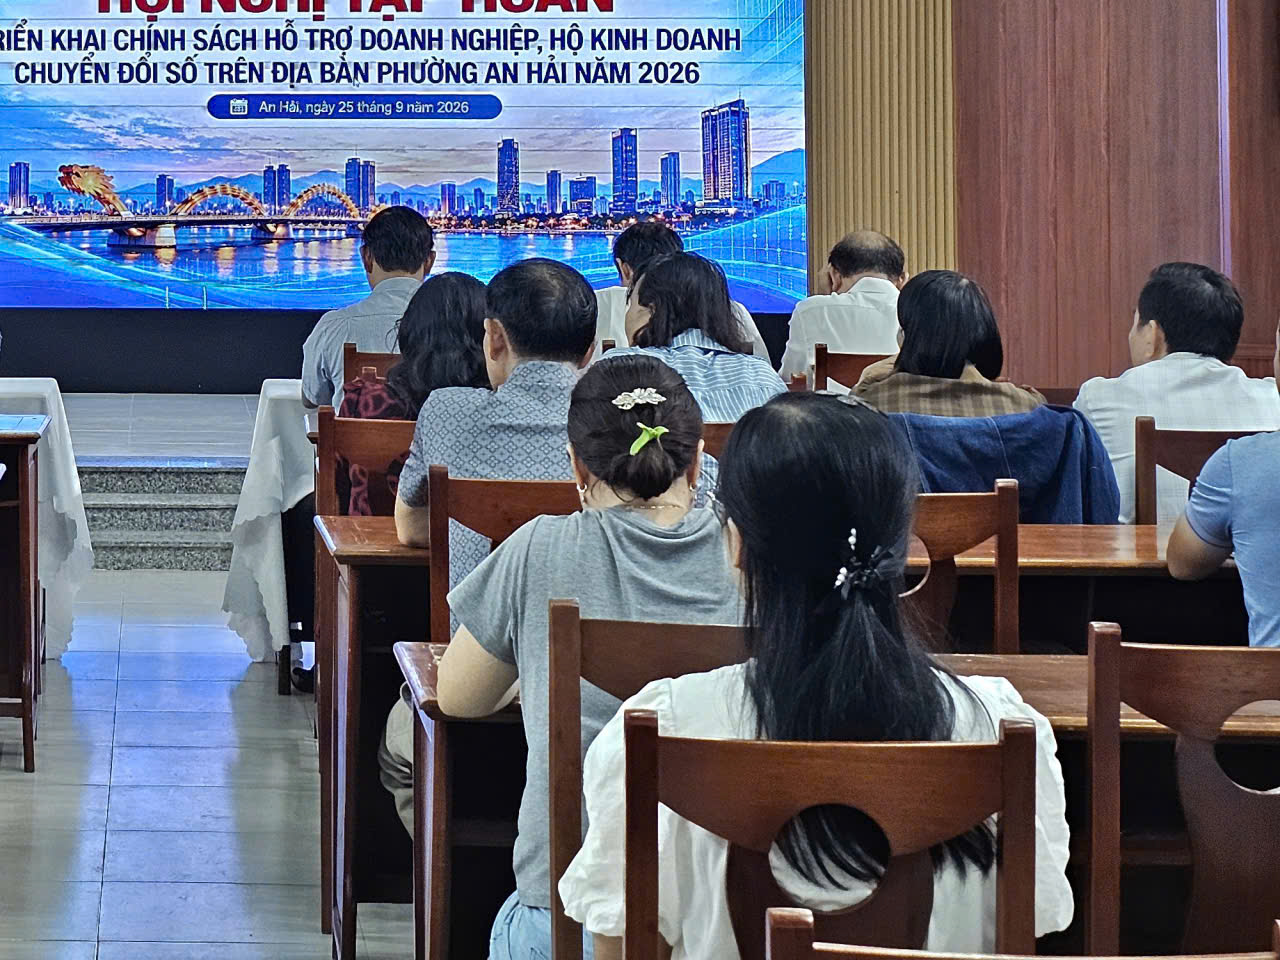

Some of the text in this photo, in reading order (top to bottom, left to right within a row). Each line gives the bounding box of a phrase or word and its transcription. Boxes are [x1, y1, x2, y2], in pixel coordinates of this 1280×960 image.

[51, 29, 106, 51] KHAI
[113, 23, 186, 51] CHÍNH
[193, 23, 257, 51] SÁCH
[264, 18, 298, 51] HỖ
[304, 25, 354, 56] TRỢ
[360, 28, 443, 51] DOANH
[451, 22, 543, 56] NGHIỆP,
[550, 22, 584, 56] HỘ
[591, 28, 648, 51] KINH
[656, 28, 741, 51] DOANH
[14, 51, 700, 89] CHUYỂN ĐỔI SỐ TRÊN ĐỊA BÀN PHƯỜNG AN HẢI NĂM 2026
[258, 100, 276, 113] An
[305, 100, 336, 116] ngày
[338, 100, 354, 113] 25
[356, 100, 392, 116] tháng
[395, 100, 404, 113] 9
[406, 100, 434, 113] năm
[436, 100, 470, 114] 2026
